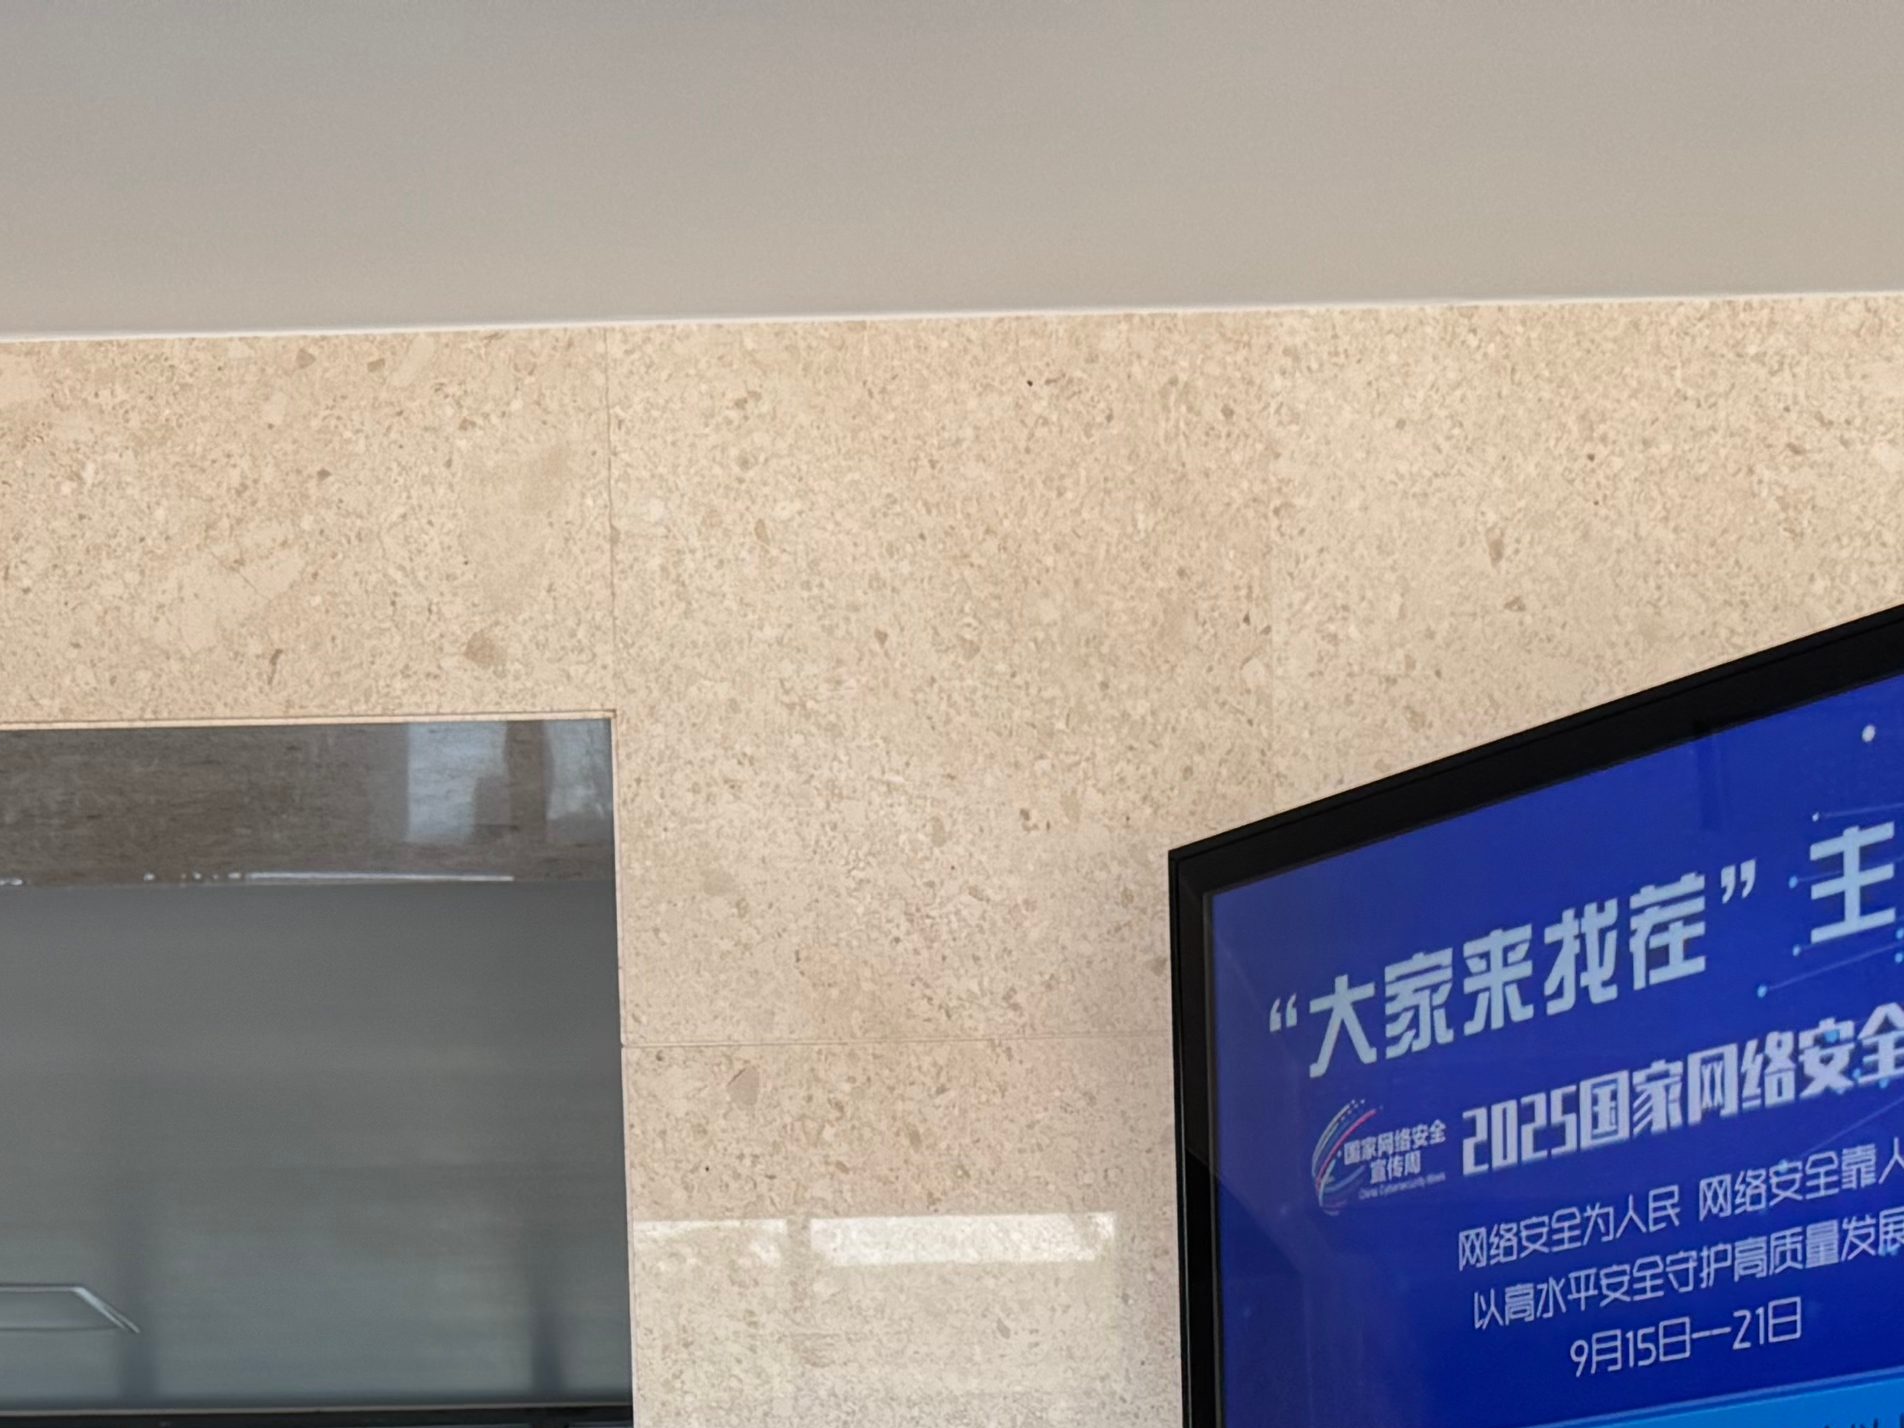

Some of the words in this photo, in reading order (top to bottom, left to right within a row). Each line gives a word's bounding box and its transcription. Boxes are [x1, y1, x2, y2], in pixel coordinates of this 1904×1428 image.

[1268, 859, 1756, 1077] “大家来找茬”
[1344, 1119, 1446, 1165] 国家网络安全
[1370, 1150, 1421, 1184] 宣传周
[1458, 1185, 1681, 1271] 网络安全为人民
